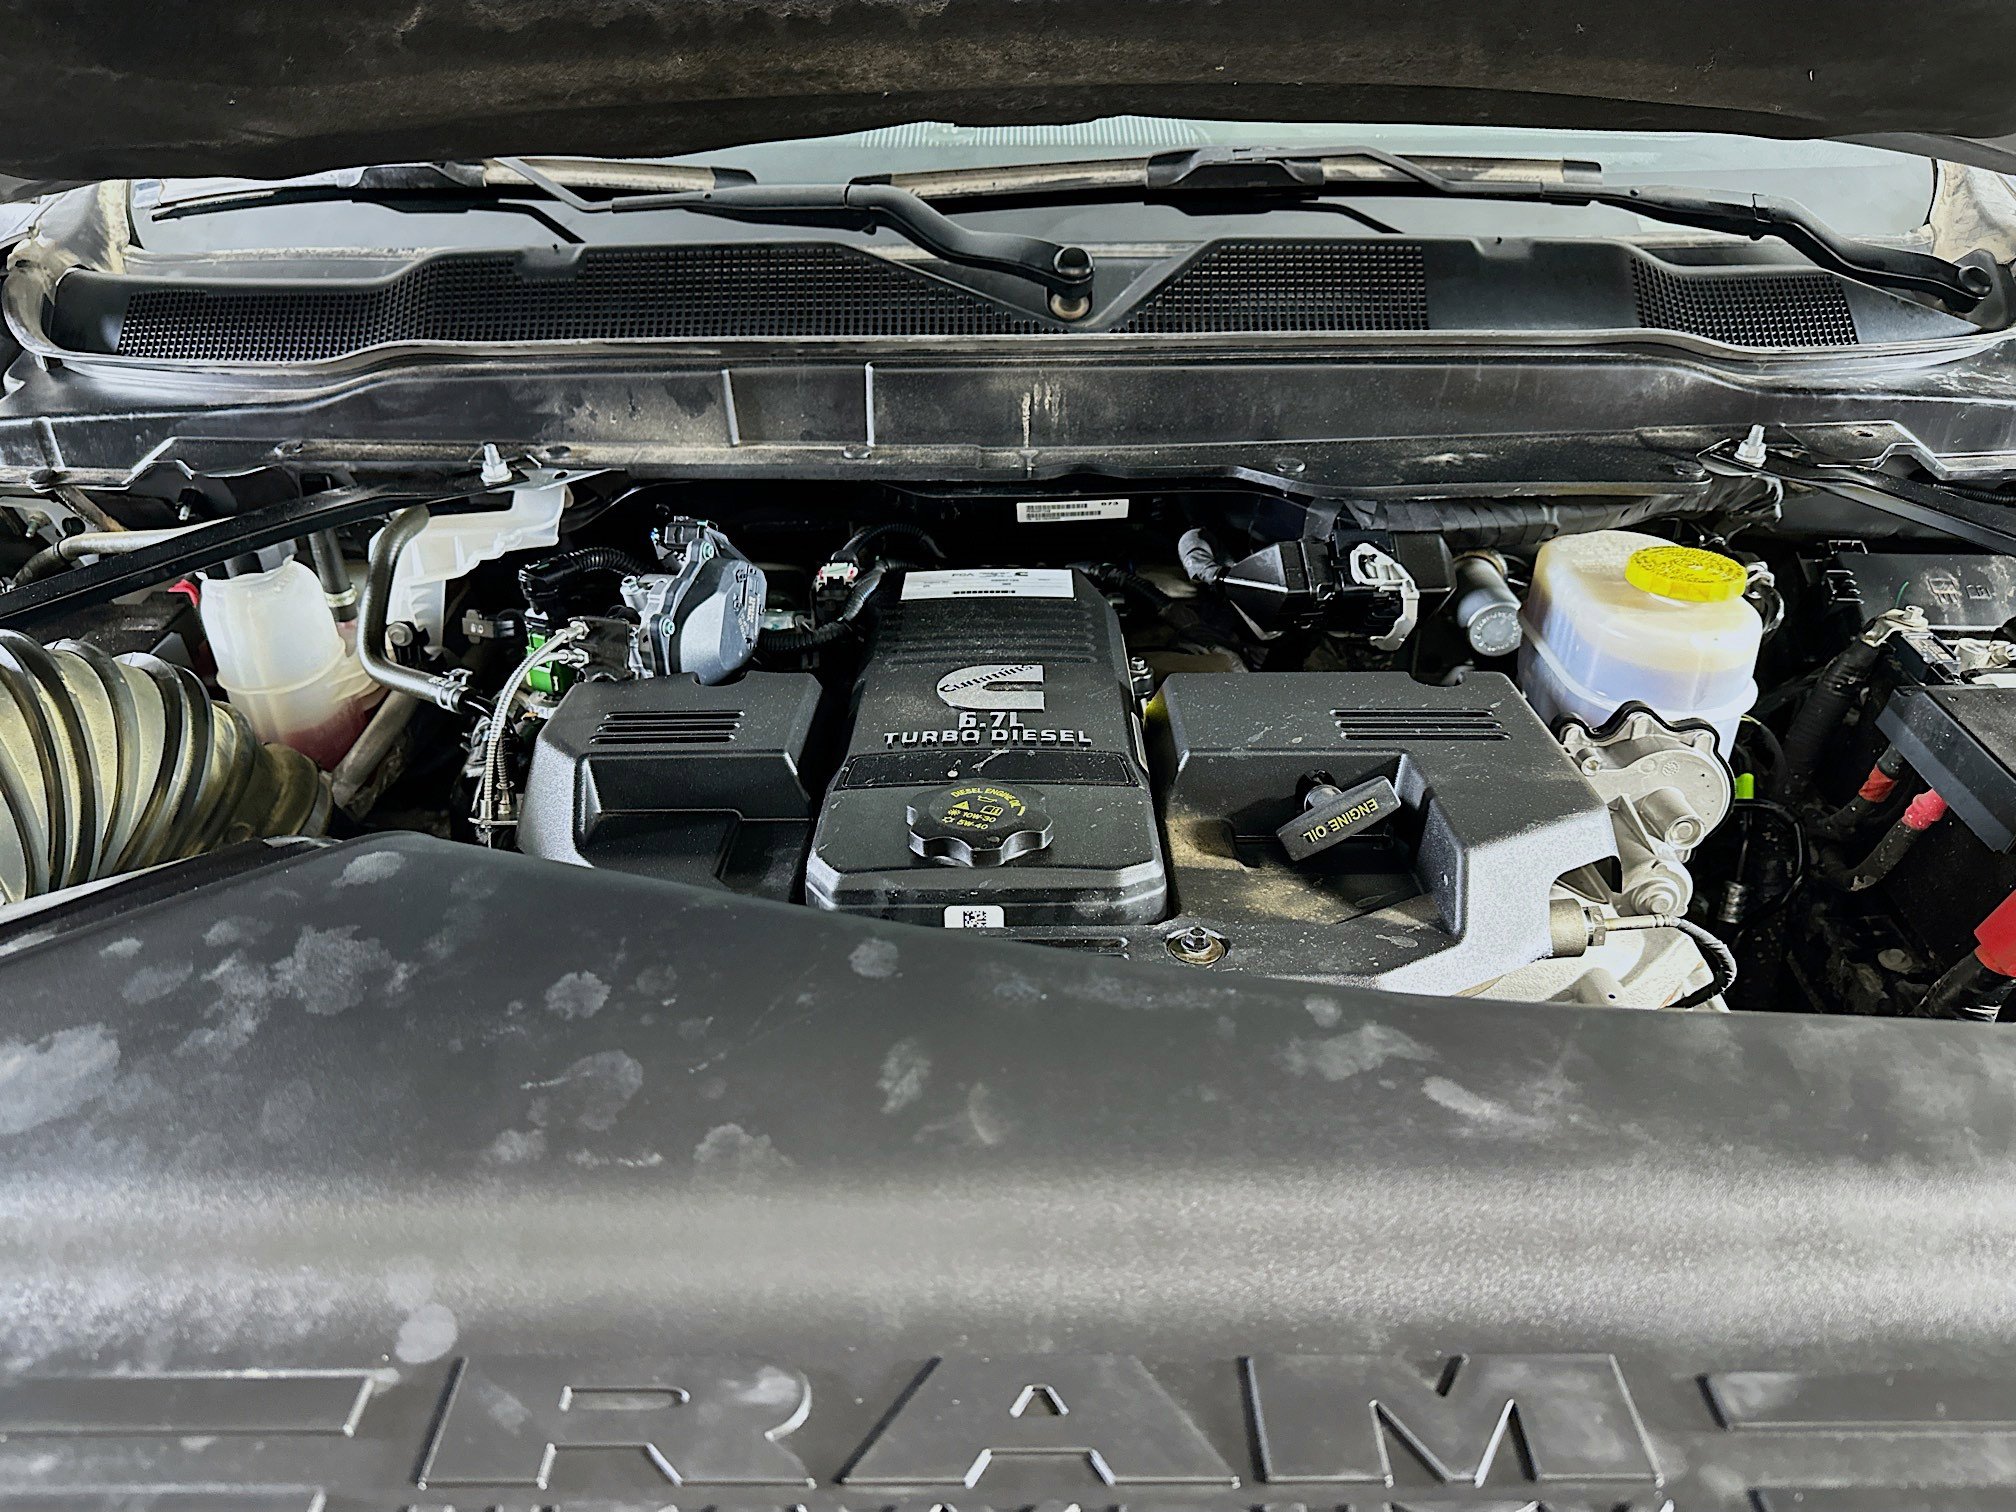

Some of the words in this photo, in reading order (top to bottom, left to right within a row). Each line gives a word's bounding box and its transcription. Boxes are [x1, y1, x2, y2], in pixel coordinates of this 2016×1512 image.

[939, 664, 1033, 692] Cummins
[958, 711, 1024, 731] 6.7L
[884, 730, 980, 748] TURBO
[991, 729, 1093, 746] DIESEL
[951, 787, 983, 798] DIESEL
[985, 787, 1016, 801] ENGINE
[962, 811, 997, 823] 10W-30
[1328, 797, 1379, 832] ENGINE
[956, 819, 989, 830] 5W-40
[1303, 825, 1327, 843] OIL
[413, 1354, 1664, 1488] RAM
